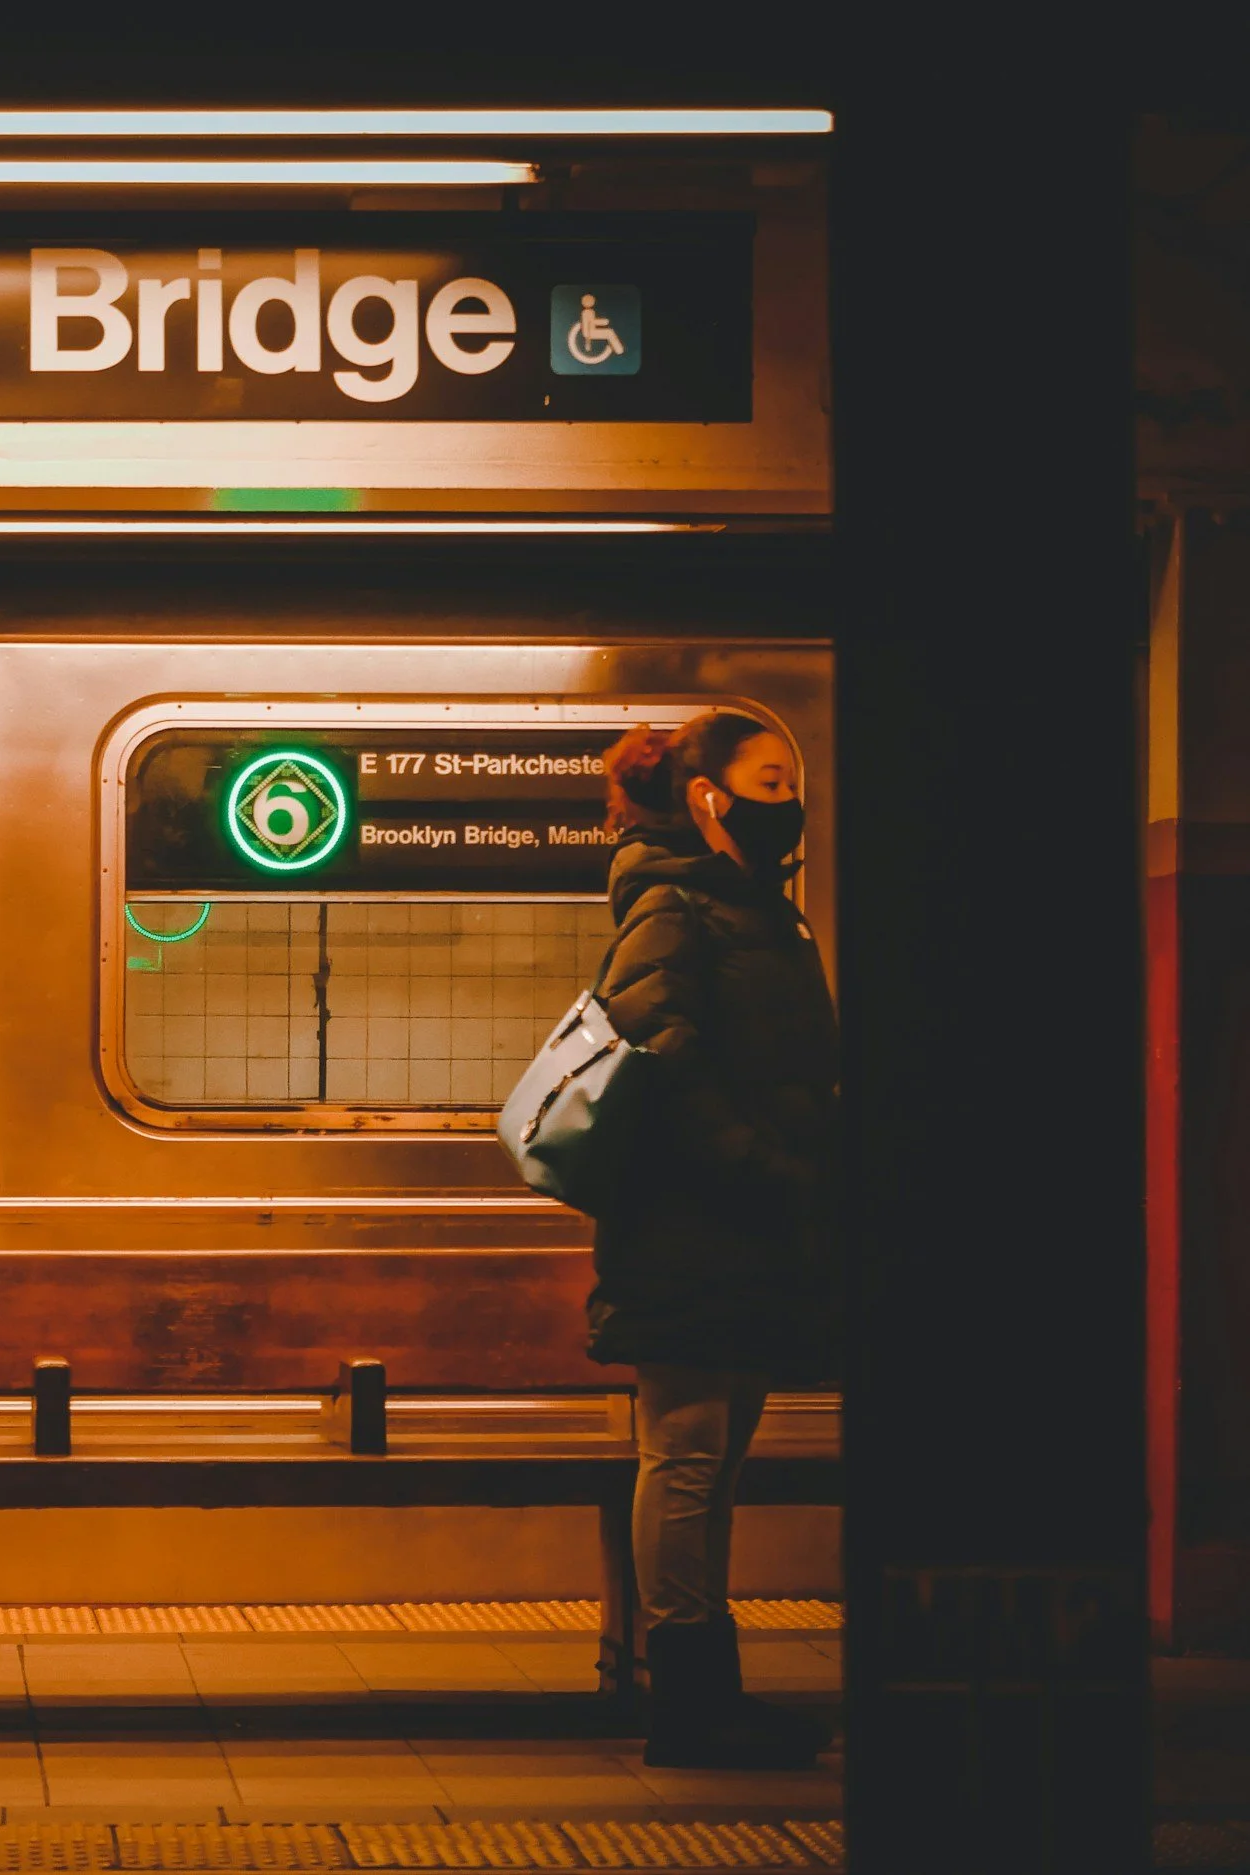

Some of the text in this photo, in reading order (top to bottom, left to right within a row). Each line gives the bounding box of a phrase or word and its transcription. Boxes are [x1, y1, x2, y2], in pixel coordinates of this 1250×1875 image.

[30, 248, 517, 403] Bridge
[361, 753, 377, 774] E
[386, 753, 426, 774] 177
[253, 781, 309, 846] 6
[361, 825, 625, 848] Brooklyn Bridge, Manha
